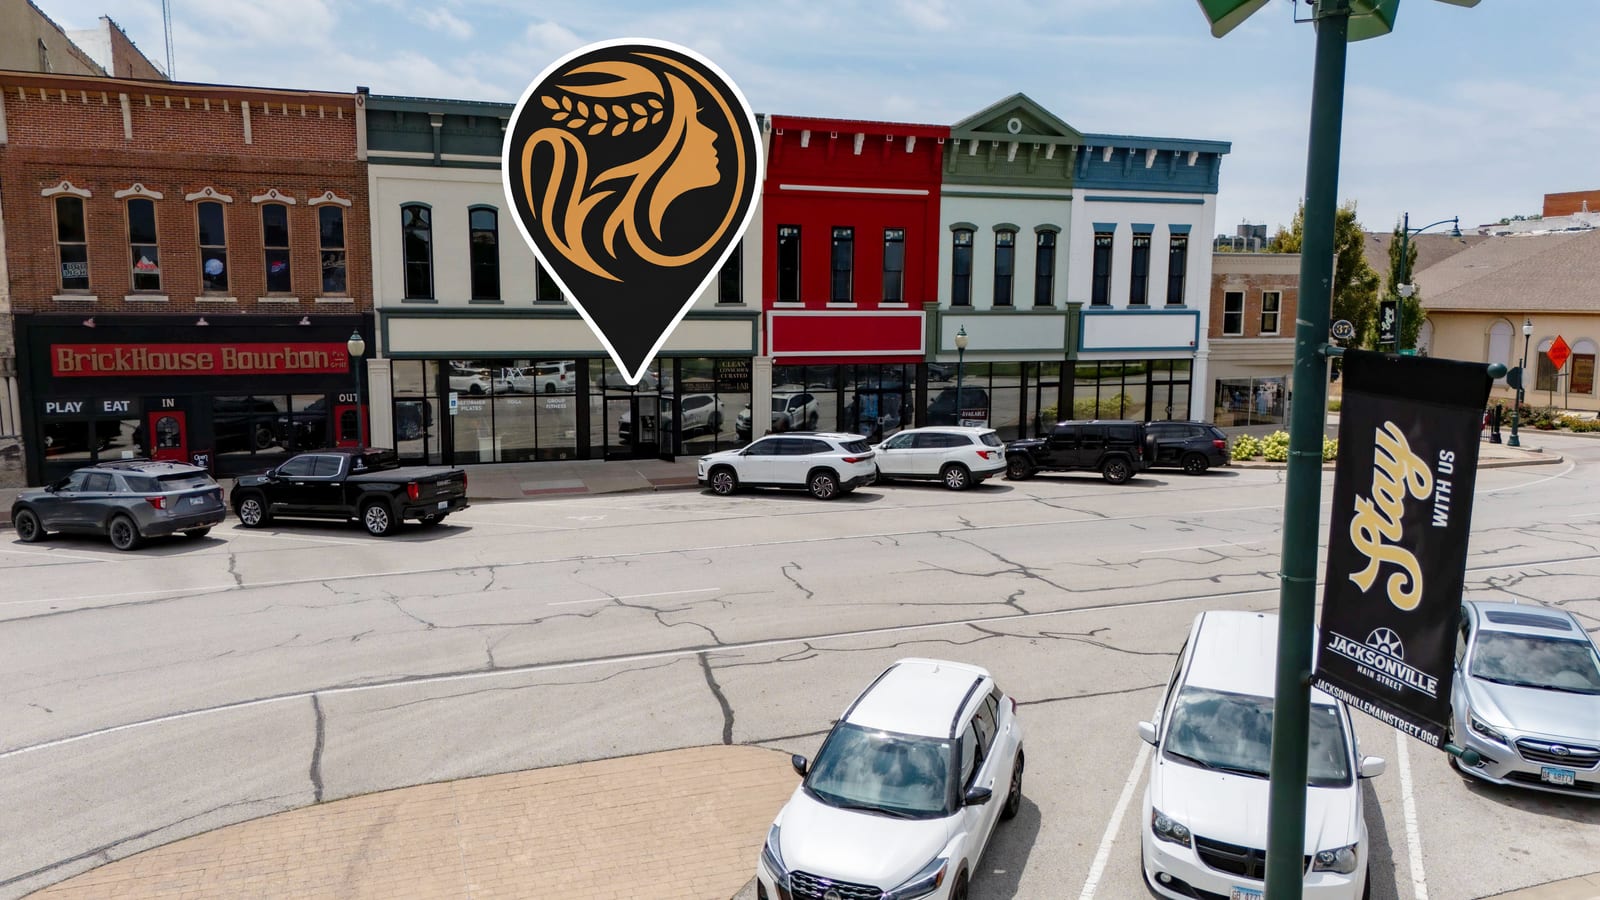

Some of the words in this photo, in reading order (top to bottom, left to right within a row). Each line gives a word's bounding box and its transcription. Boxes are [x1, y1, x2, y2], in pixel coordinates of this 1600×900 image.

[1336, 325, 1350, 334] 37
[57, 347, 214, 371] BrickHouse
[221, 347, 329, 370] Bourbon
[46, 401, 83, 413] PLAY
[103, 400, 130, 412] EAT
[162, 398, 175, 408] IN
[1437, 449, 1455, 475] US
[1349, 420, 1433, 611] Stay
[1432, 479, 1453, 528] WITH
[1328, 636, 1438, 695] JACKSONVILLE
[1357, 665, 1375, 679] MAIN
[1376, 674, 1404, 692] STREET
[1315, 678, 1440, 747] JACKSONVILLEMAINSTREET.ORG
